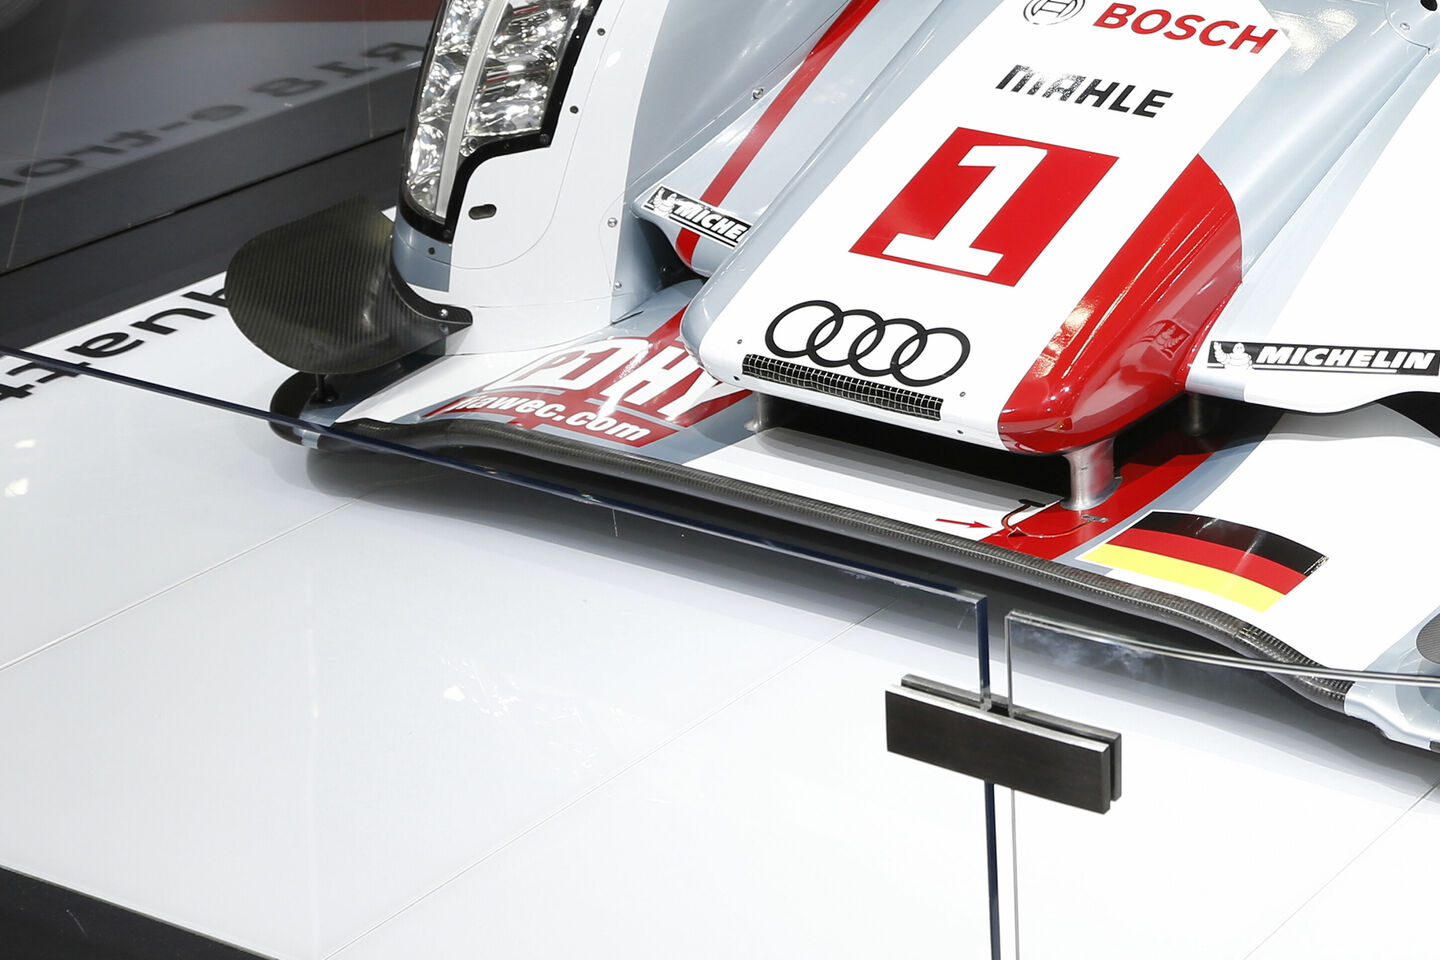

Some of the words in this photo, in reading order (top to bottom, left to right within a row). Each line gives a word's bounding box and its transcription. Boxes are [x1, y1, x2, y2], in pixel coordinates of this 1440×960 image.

[1092, 2, 1279, 54] BOSCH
[995, 64, 1175, 118] MAHLE
[673, 203, 749, 240] MICHE
[881, 145, 1048, 276] 1
[1255, 345, 1436, 371] MICHELIN
